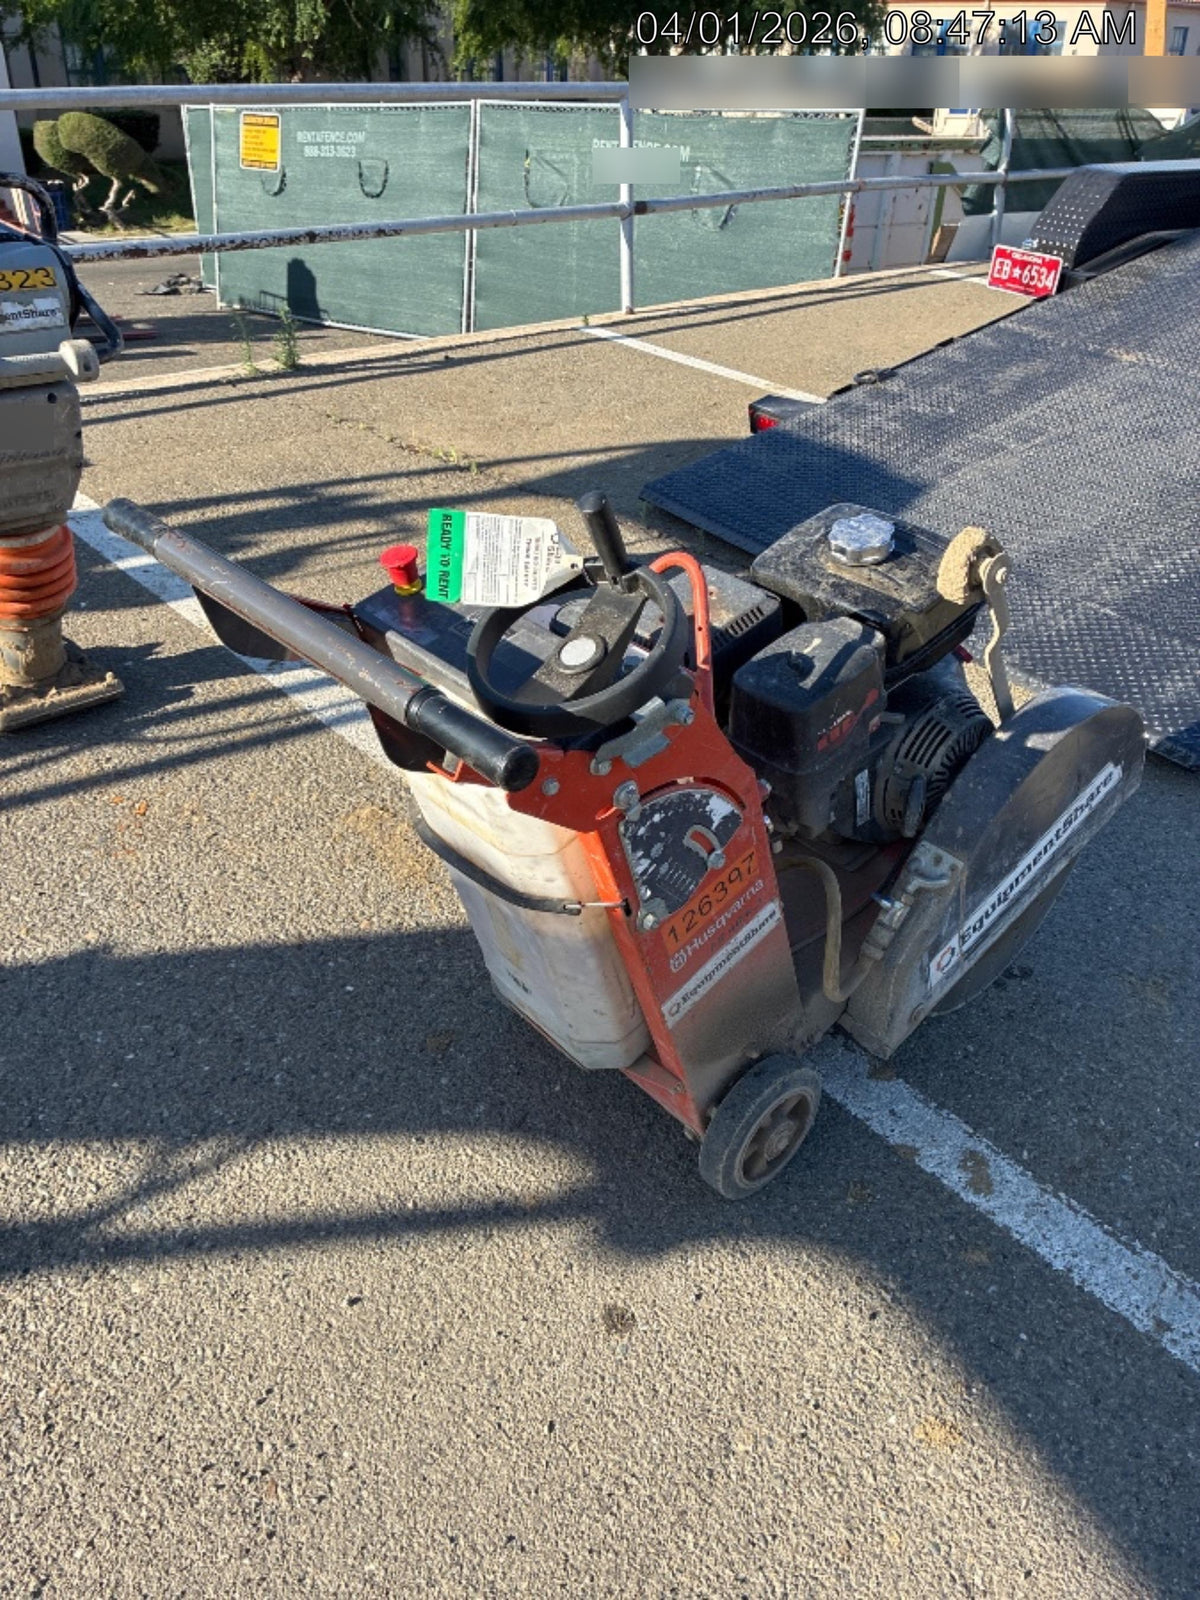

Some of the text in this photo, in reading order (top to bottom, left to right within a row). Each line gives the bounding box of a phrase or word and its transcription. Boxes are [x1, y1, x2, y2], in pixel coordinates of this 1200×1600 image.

[440, 513, 453, 550] READY
[437, 570, 451, 600] RENT
[961, 771, 1114, 946] EquipmentShare
[668, 852, 756, 944] 126397
[685, 879, 764, 956] Husqvarna
